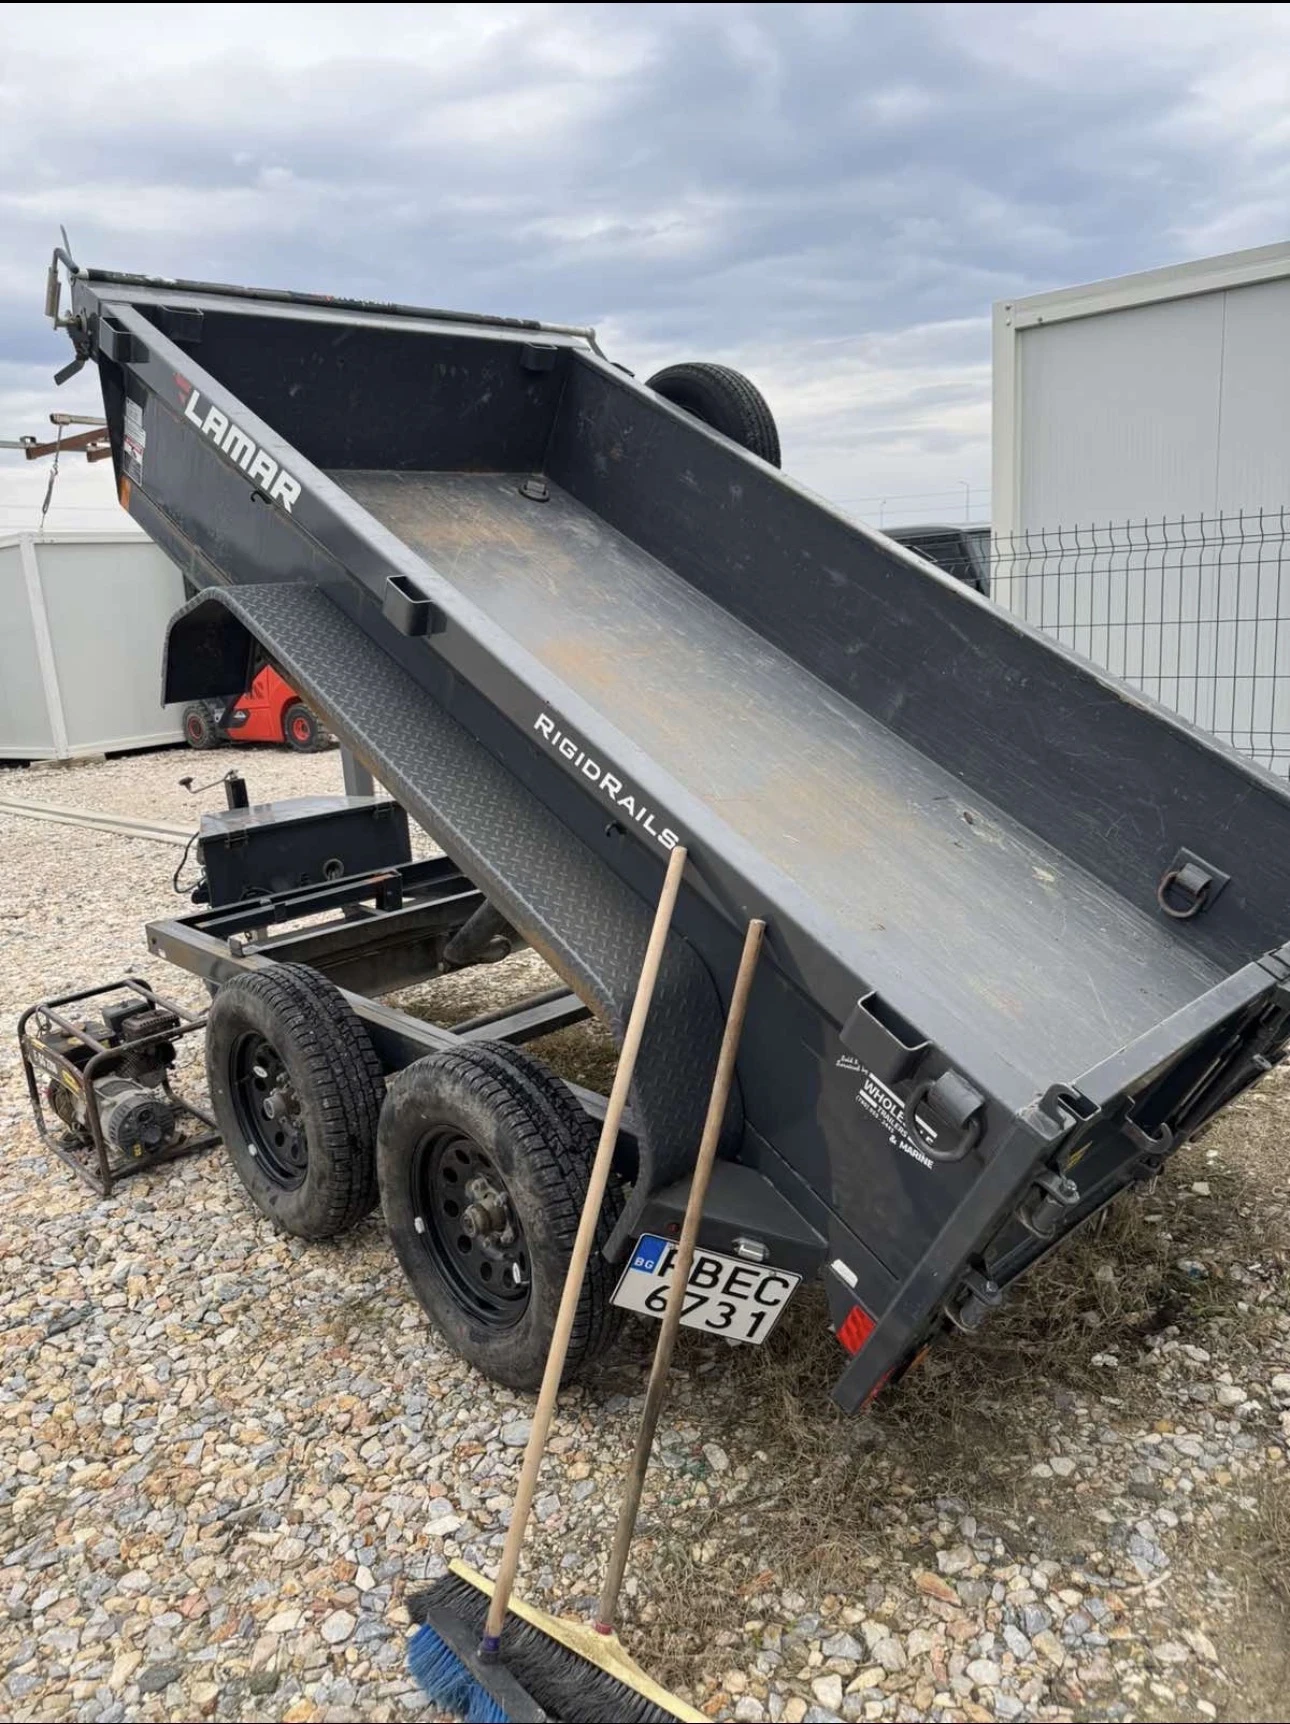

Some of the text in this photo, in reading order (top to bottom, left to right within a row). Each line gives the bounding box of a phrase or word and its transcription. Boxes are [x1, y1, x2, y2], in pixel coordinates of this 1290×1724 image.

[184, 390, 302, 514] LAMAR
[533, 713, 680, 850] RIGIDRAILS
[877, 1105, 908, 1138] TRAILERS
[889, 1134, 934, 1170] & MARINE
[634, 1256, 655, 1270] BG
[644, 1285, 767, 1338] 6731
